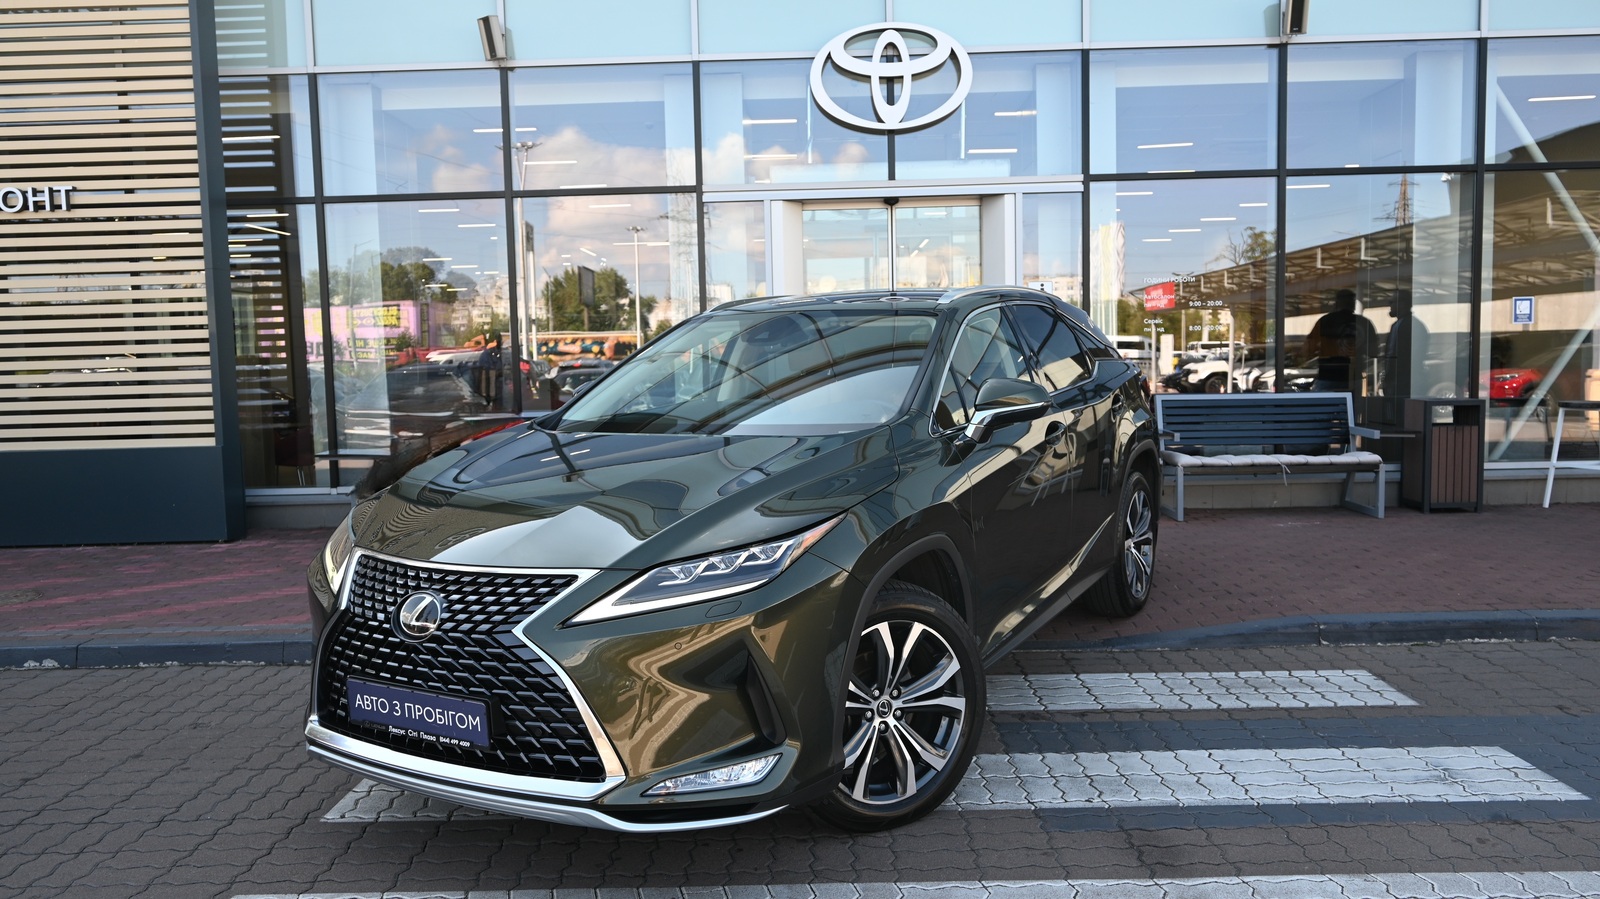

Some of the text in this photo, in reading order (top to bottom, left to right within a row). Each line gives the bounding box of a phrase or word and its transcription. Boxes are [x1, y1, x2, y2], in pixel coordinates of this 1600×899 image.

[355, 693, 389, 714] АВТО
[404, 703, 481, 732] ПРОБІГОМ
[450, 738, 459, 746] 499
